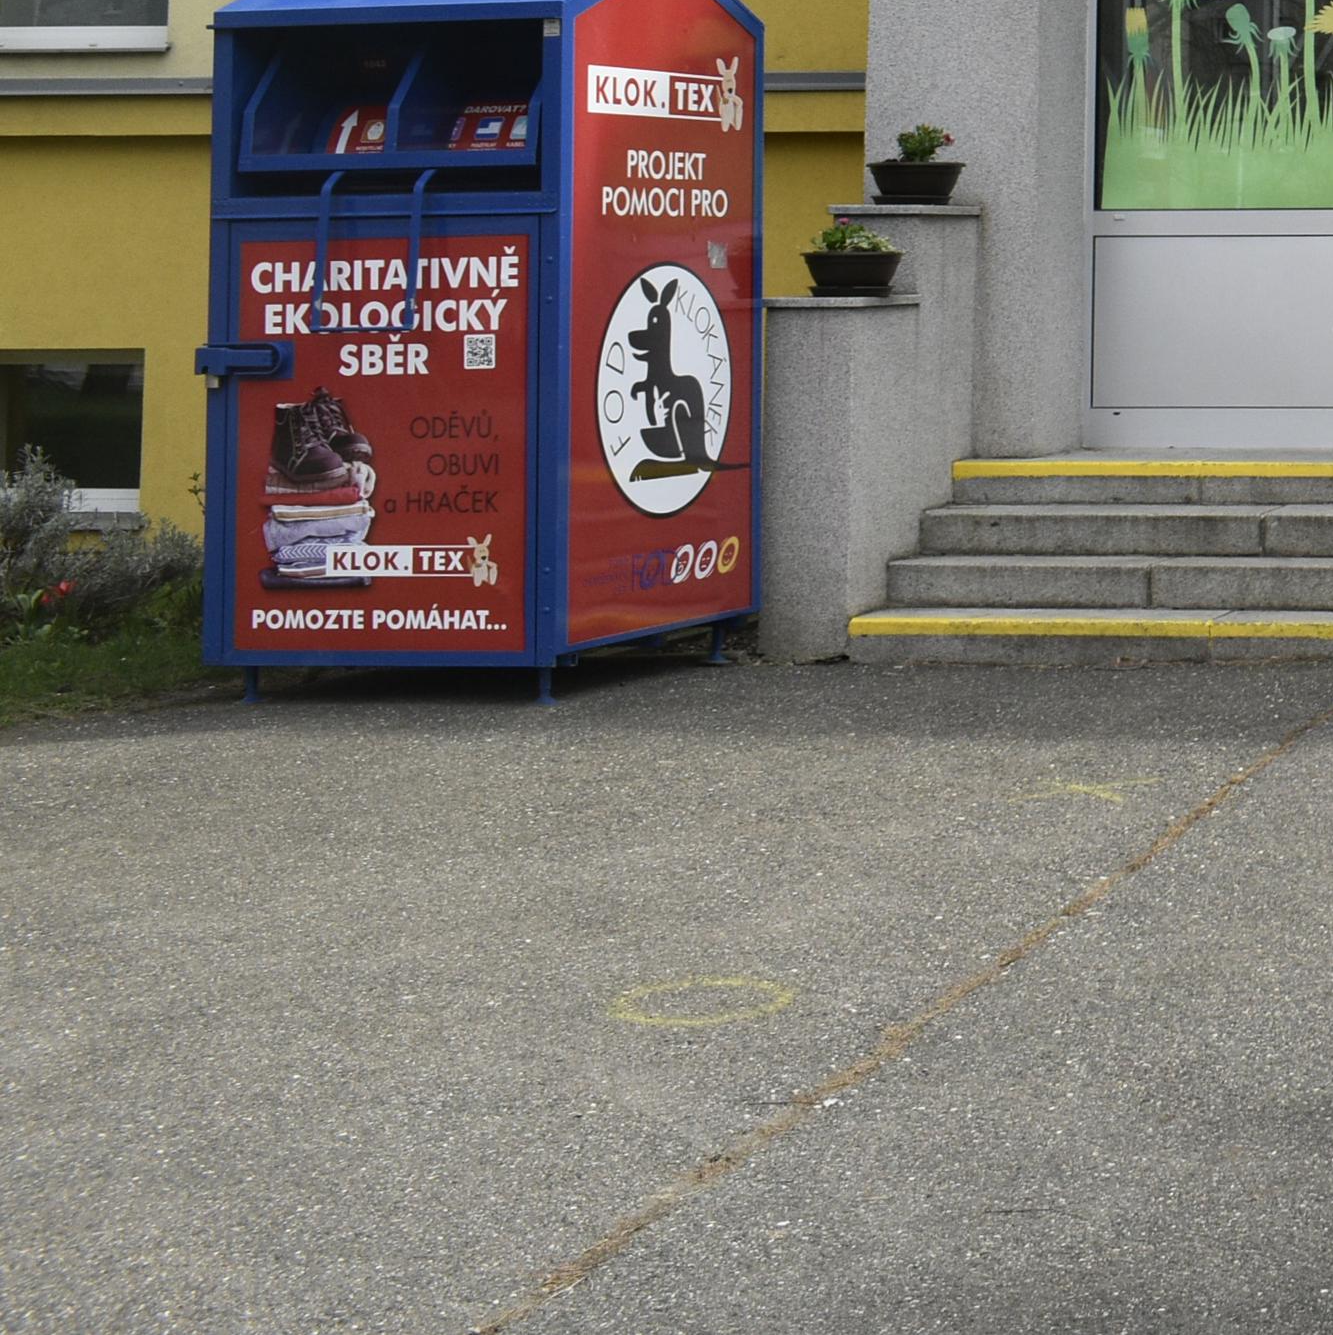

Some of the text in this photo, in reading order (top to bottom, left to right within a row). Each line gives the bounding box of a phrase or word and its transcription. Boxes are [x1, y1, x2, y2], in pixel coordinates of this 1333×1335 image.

[626, 149, 707, 181] PROJEKT
[601, 185, 729, 218] POMOCI PRO
[250, 245, 520, 294] CHARITATIVNĚ
[264, 288, 509, 335] EKOLOGICKÝ
[338, 333, 430, 377] SBĚR
[674, 285, 728, 447] KLOKÁNEK
[602, 341, 632, 457] FOD
[426, 452, 500, 477] OBUVI
[383, 484, 499, 515] a HRAČEK
[251, 603, 508, 632] POMOZTE POMÁHAT...
